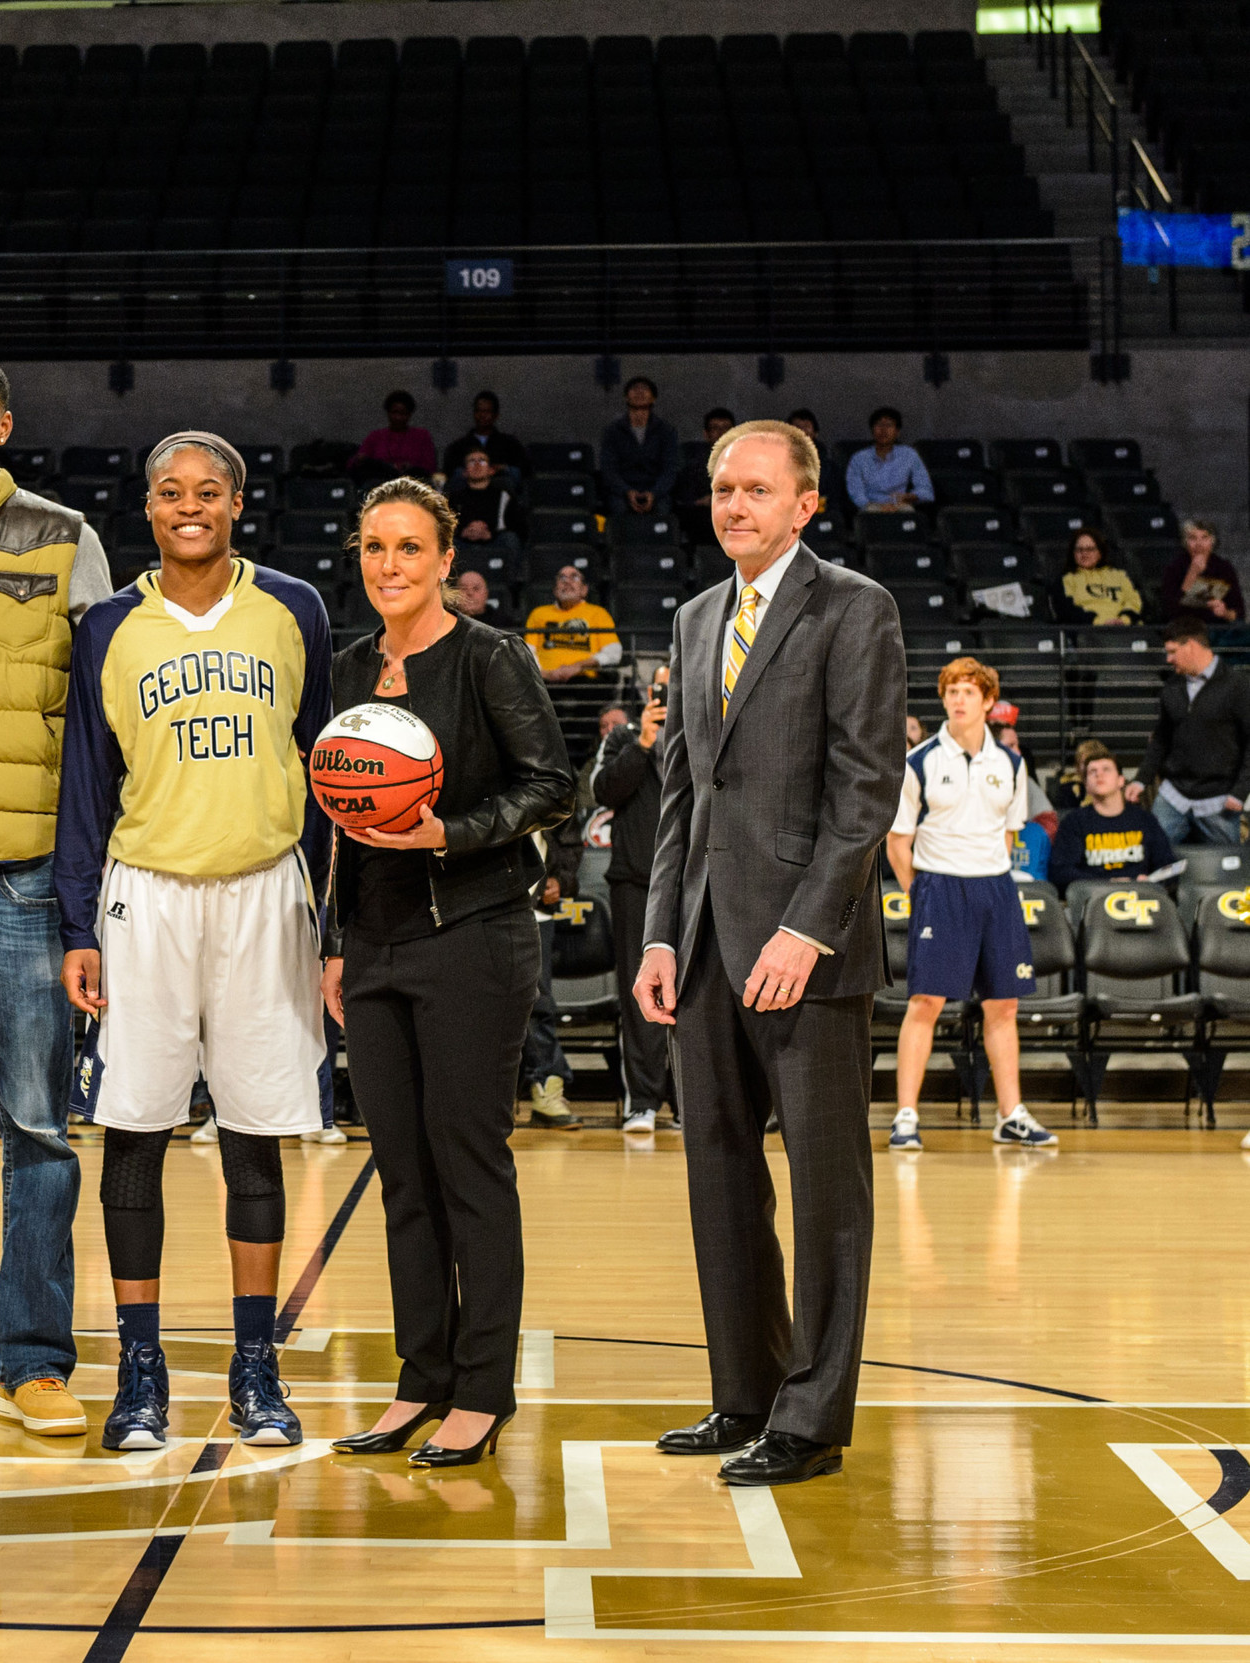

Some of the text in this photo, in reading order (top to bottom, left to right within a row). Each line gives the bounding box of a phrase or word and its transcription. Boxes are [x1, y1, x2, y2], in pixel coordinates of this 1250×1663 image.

[459, 267, 501, 289] 109
[138, 649, 276, 720] GEORGIA
[339, 713, 371, 732] GT
[169, 713, 254, 764] TECH
[312, 748, 386, 777] Wilson
[321, 792, 377, 814] NCAA
[1104, 890, 1160, 925] GT
